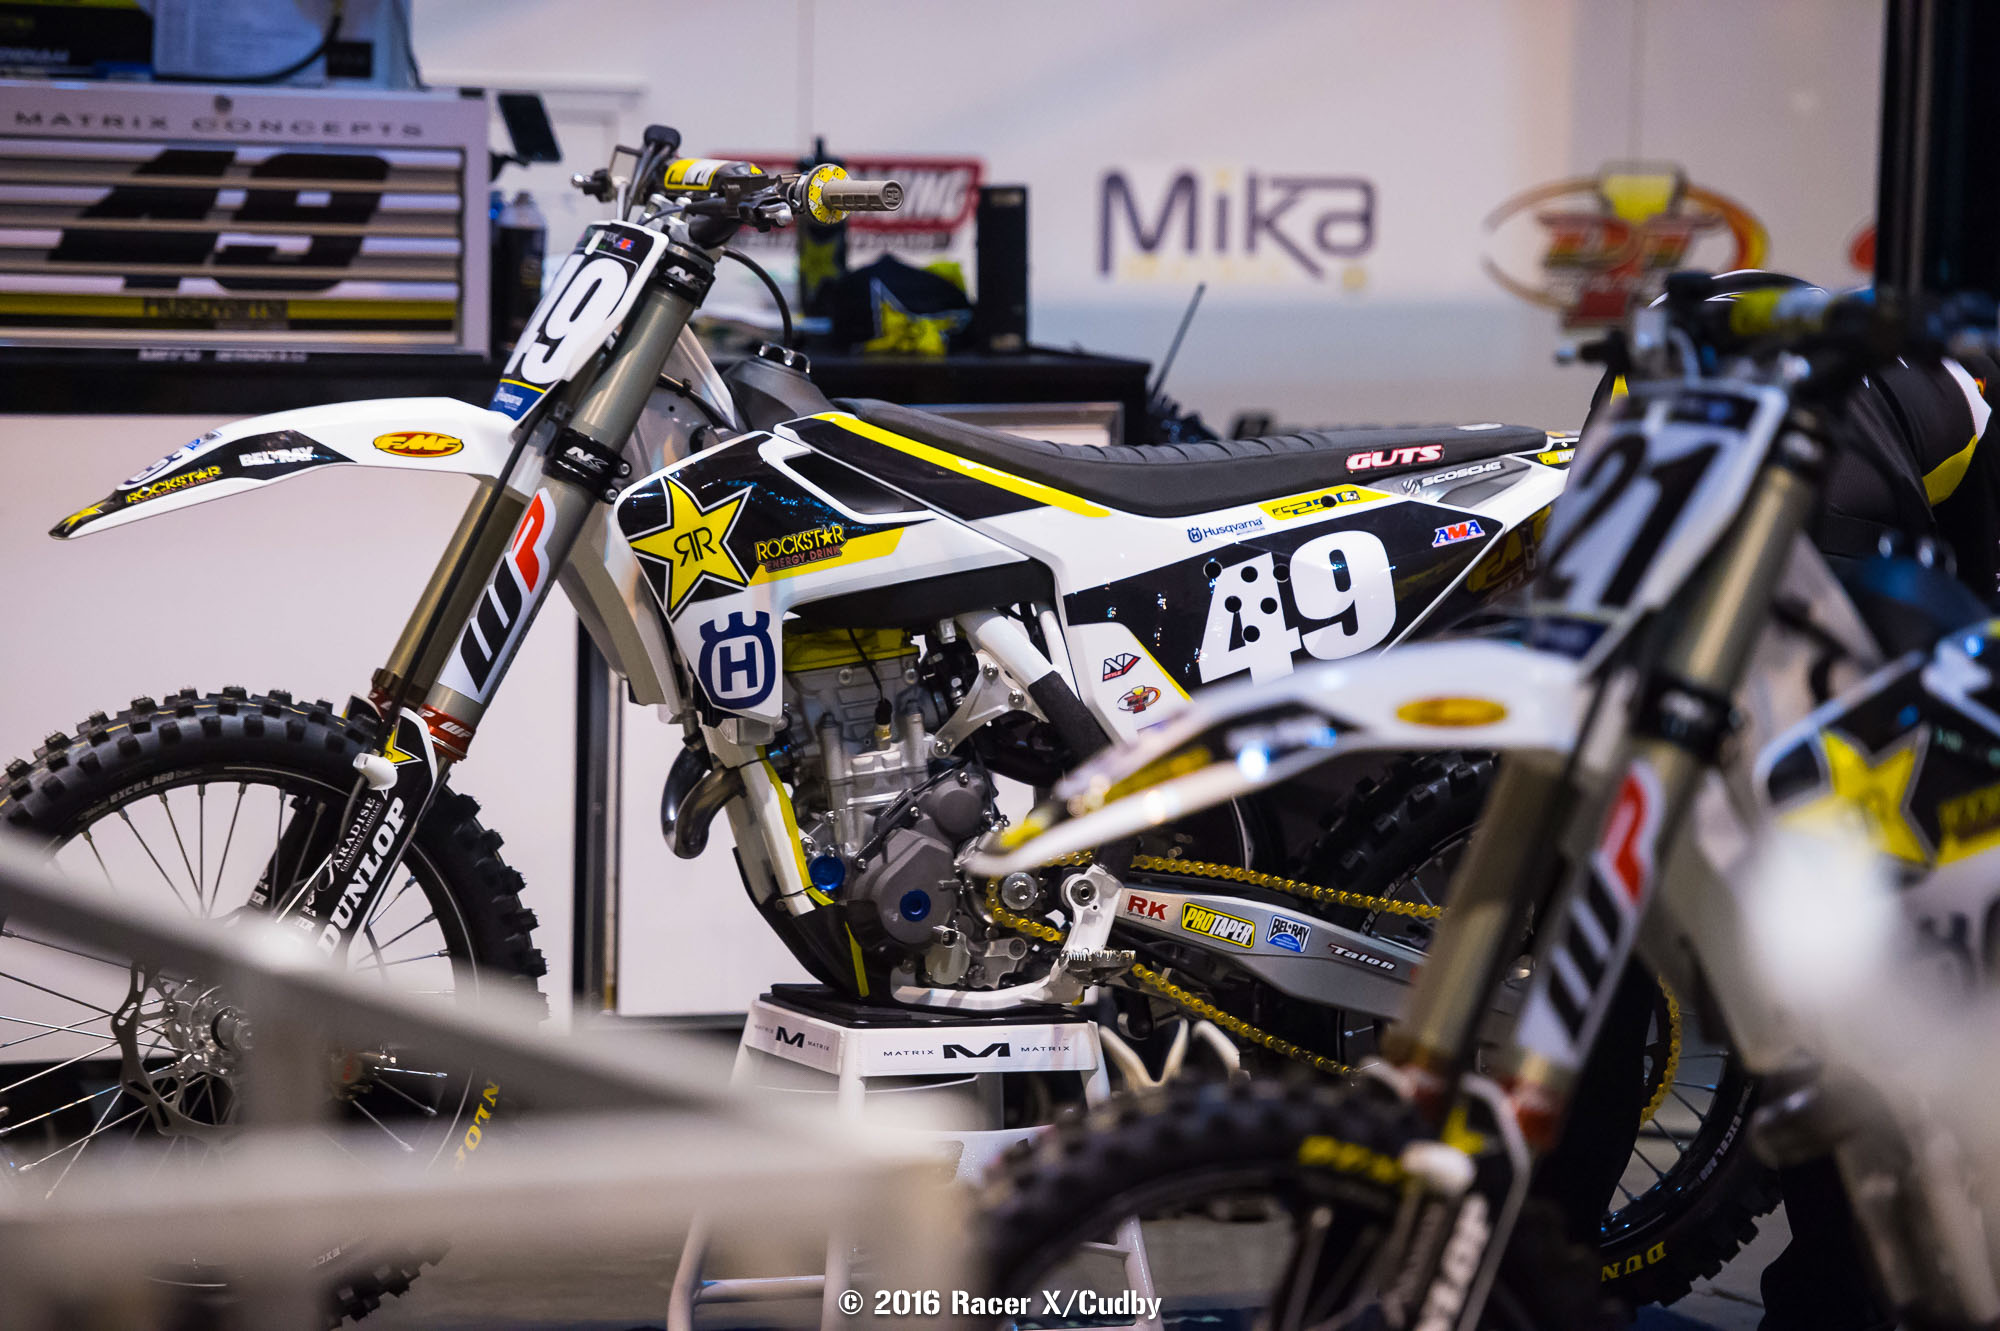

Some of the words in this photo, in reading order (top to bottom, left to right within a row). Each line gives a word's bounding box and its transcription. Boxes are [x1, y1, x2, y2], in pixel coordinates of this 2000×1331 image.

[14, 110, 169, 130] MATRIX
[191, 115, 424, 138] CONCEPTS
[1097, 168, 1379, 281] Mika
[502, 252, 630, 385] 49
[374, 432, 463, 453] FMF
[1347, 446, 1443, 470] GUTS
[126, 465, 222, 504] ROCKSTAR
[1421, 460, 1504, 488] SCOSCHE
[1203, 516, 1264, 539] Husqvarna
[1433, 519, 1485, 547] AMA
[756, 525, 845, 561] ROCKSTAR
[766, 553, 806, 570] ENERGY
[809, 545, 841, 561] DRINK
[1198, 530, 1397, 688] 49
[317, 796, 406, 956] DUNLOP
[1127, 895, 1168, 920] RK
[1329, 943, 1396, 971] Talon
[883, 1049, 935, 1057] MATRIX
